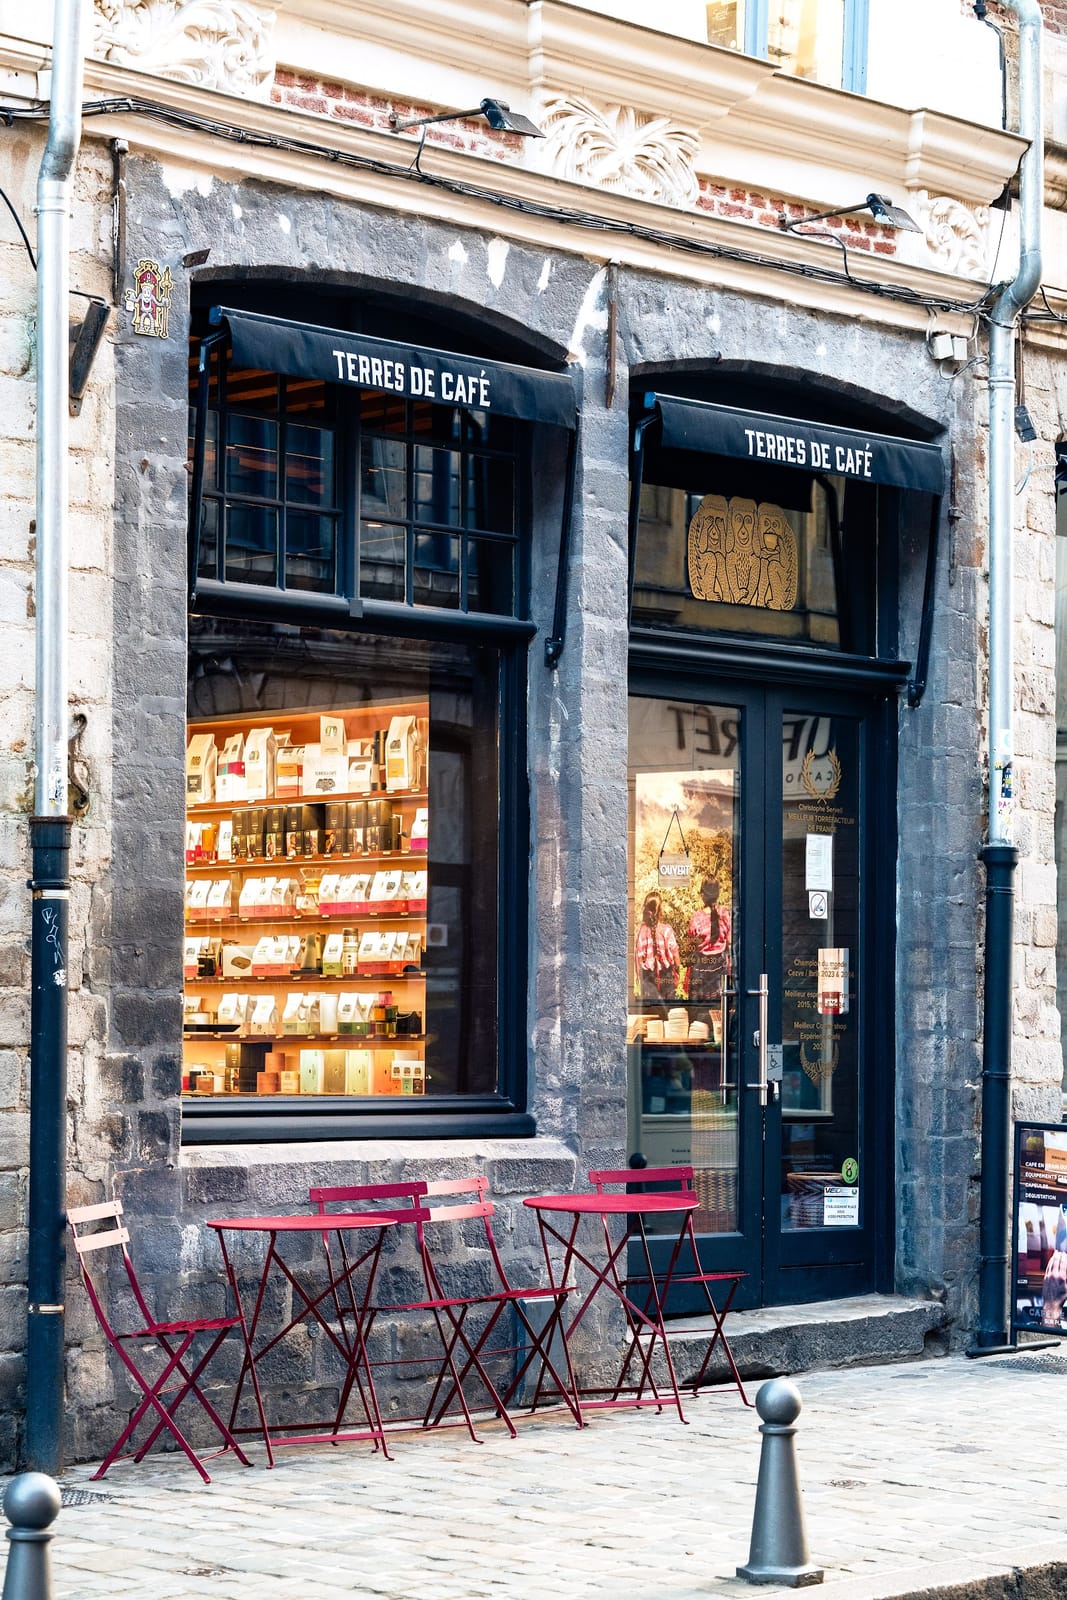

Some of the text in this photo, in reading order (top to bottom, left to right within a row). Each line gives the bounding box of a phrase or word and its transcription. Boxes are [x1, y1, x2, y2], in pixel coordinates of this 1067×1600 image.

[332, 350, 491, 407] TERRES DE CAFÉ
[744, 429, 873, 477] TERRES DE CAFÉ
[798, 803, 825, 813] Christophe
[787, 812, 814, 822] MEILLEUR
[816, 825, 837, 833] FRANCE
[660, 864, 690, 876] OUVERT
[821, 970, 835, 978] 2023
[793, 1021, 815, 1030] Meilleur
